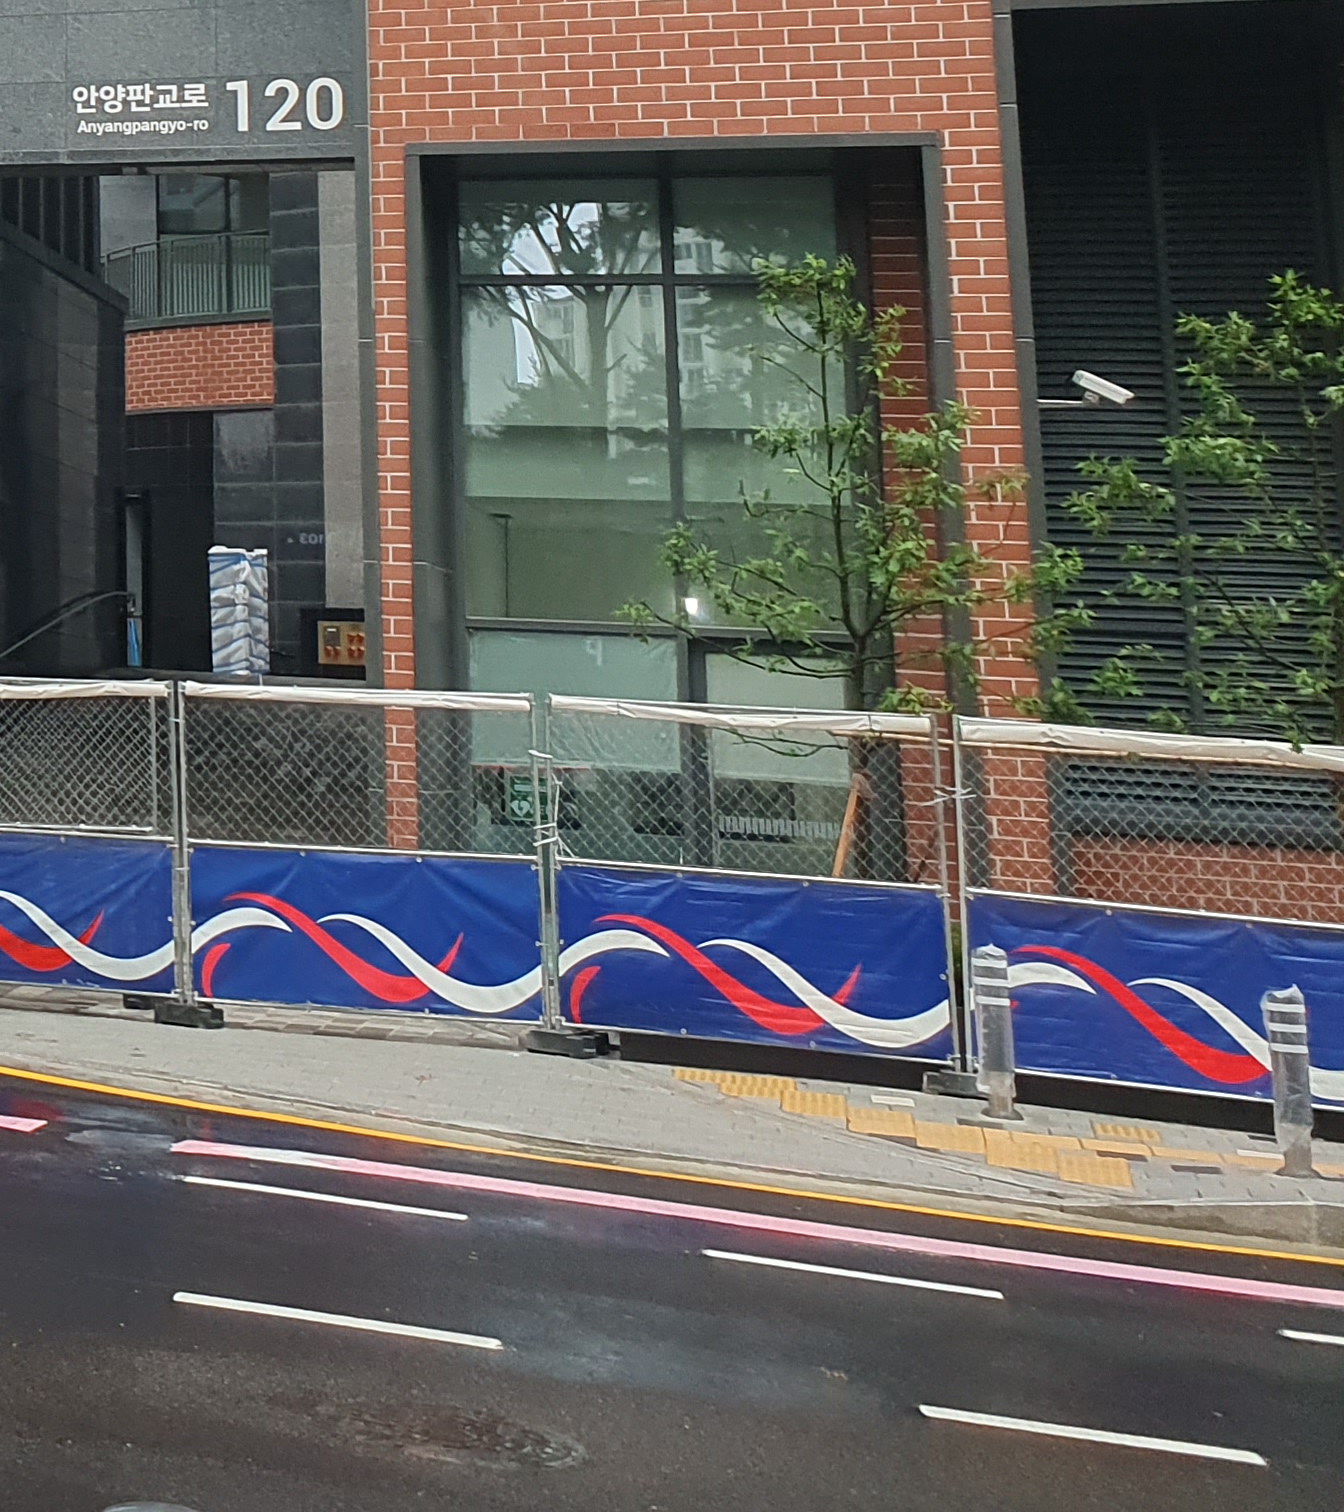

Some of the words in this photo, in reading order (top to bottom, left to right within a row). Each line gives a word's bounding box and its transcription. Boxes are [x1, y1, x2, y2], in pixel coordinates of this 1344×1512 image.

[72, 83, 209, 114] 안양판교로
[226, 77, 344, 132] 120
[77, 119, 209, 136] Anyangpangyo-ro
